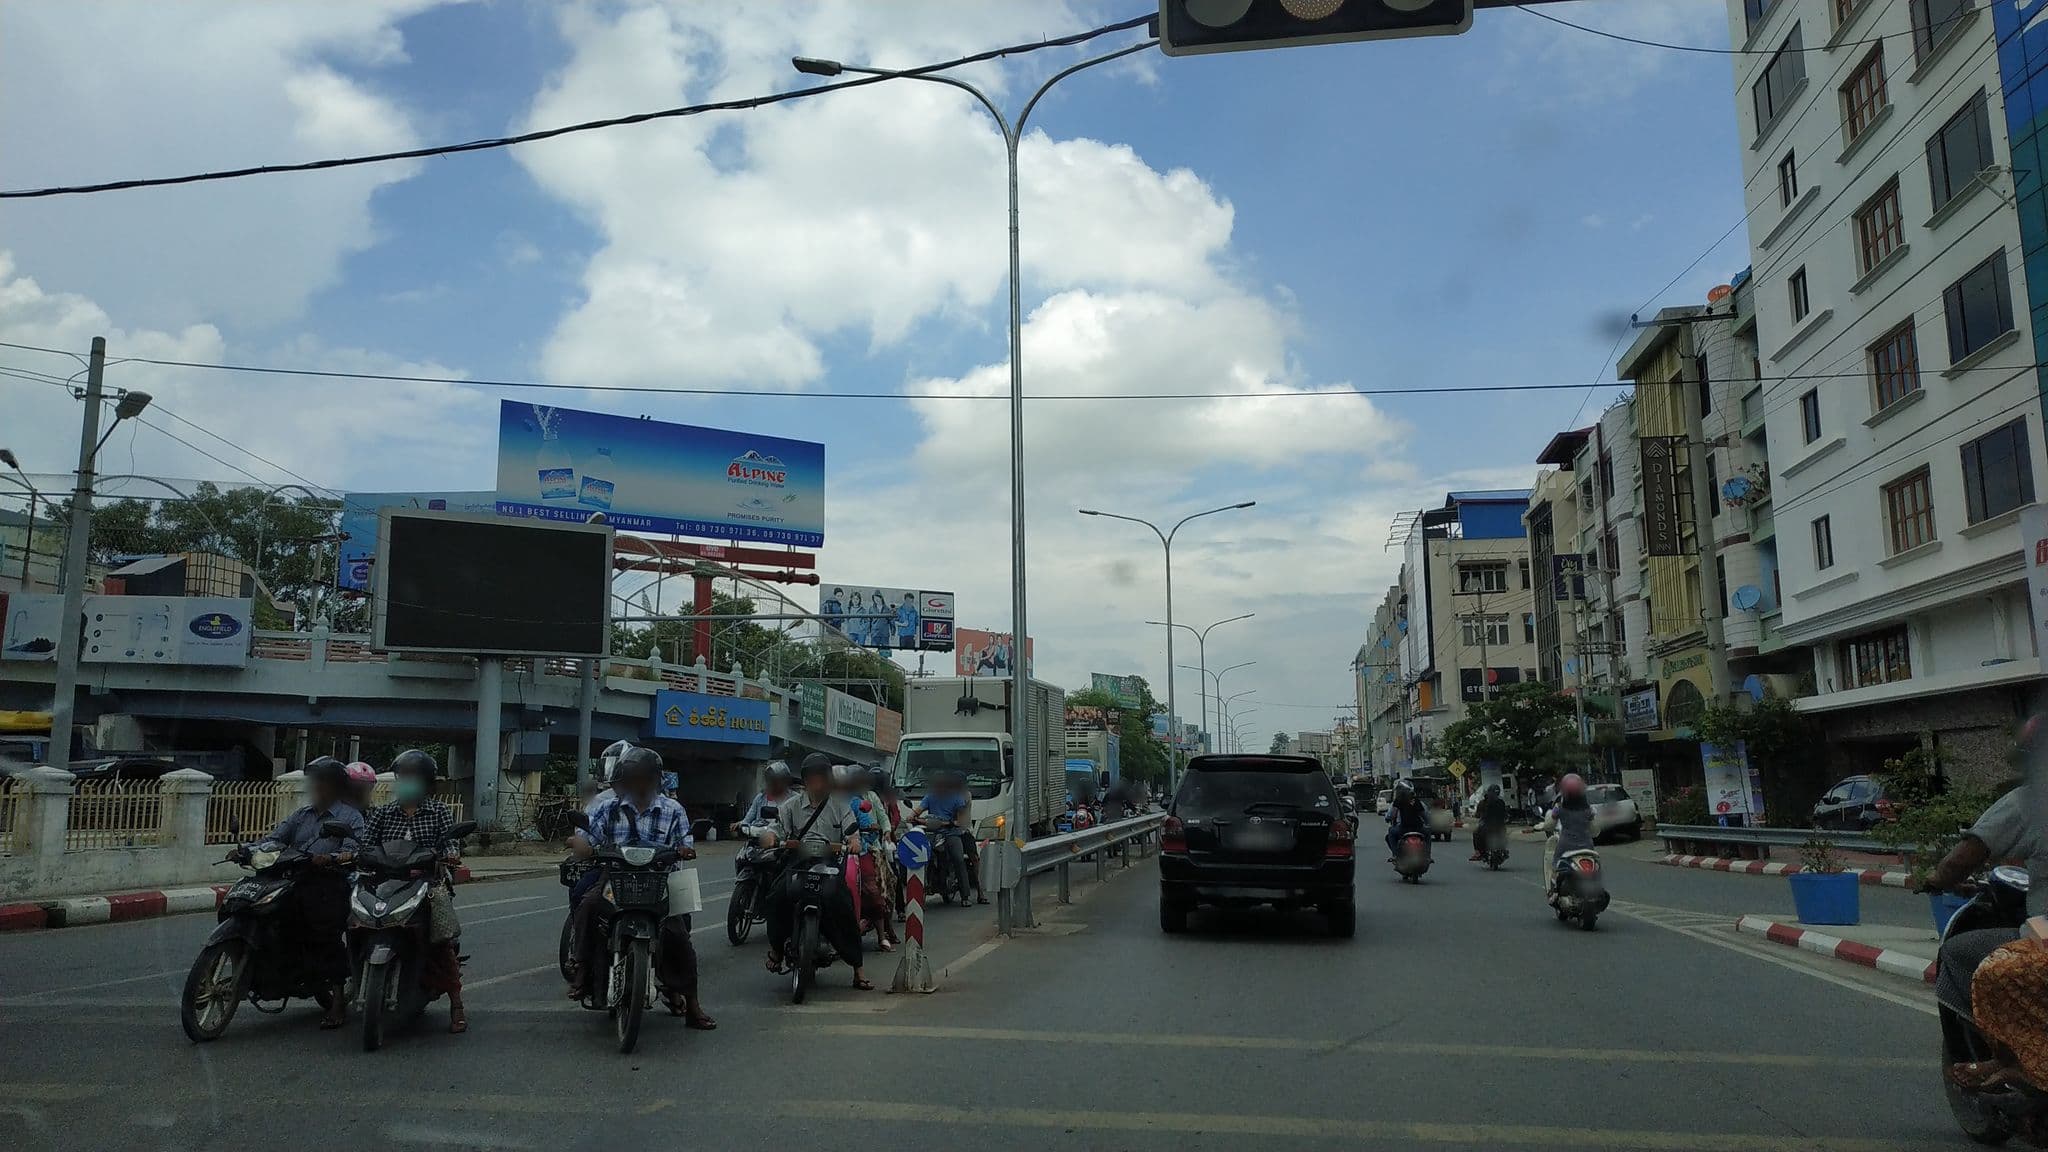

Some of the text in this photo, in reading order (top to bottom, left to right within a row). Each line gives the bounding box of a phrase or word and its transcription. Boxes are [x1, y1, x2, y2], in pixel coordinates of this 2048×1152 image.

[728, 462, 786, 482] ALPINE
[1652, 463, 1667, 541] DIAMONDS
[502, 505, 523, 514] NO.1
[527, 508, 550, 517] BEST
[609, 516, 652, 527] MYANMAR
[728, 512, 785, 523] PROMISES PURITY
[676, 522, 692, 531] Tel:
[1466, 685, 1499, 693] ETERN
[838, 697, 852, 722] White
[853, 702, 875, 728] Richmond
[730, 717, 766, 732] HOTEL
